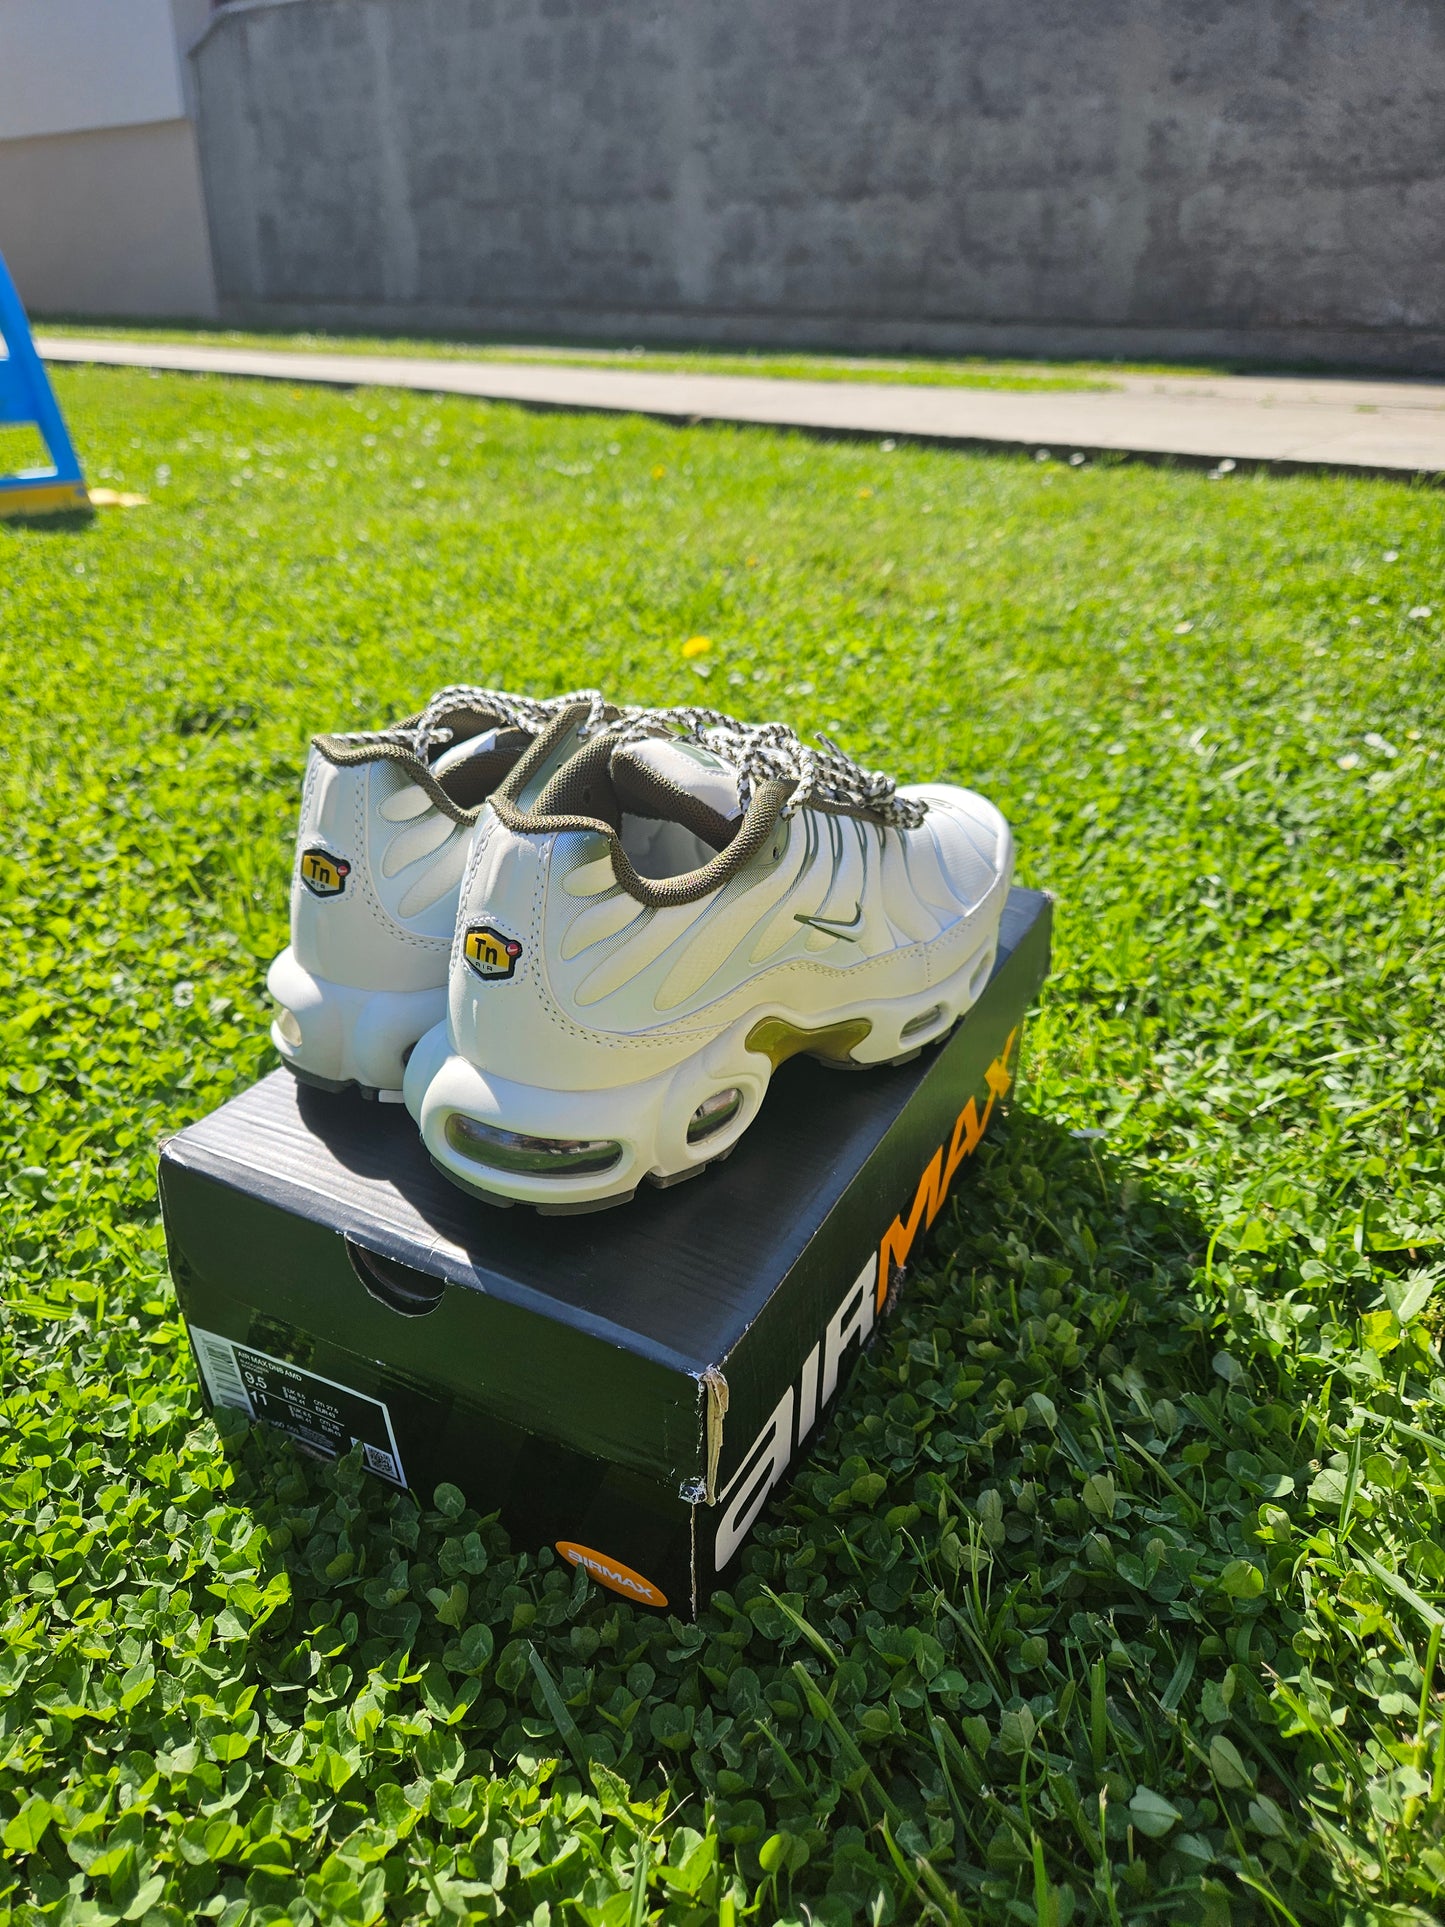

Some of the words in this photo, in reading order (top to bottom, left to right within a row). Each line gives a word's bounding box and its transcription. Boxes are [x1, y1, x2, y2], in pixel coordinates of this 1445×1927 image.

[310, 858, 330, 884] Tn
[310, 880, 326, 890] AIR
[475, 937, 498, 966] Tn
[475, 961, 494, 972] AIR
[238, 1351, 250, 1361] AIR
[250, 1356, 268, 1369] MAX
[244, 1371, 268, 1389] 9.5
[250, 1391, 268, 1406] 11
[568, 1549, 653, 1599] AIRMAX
